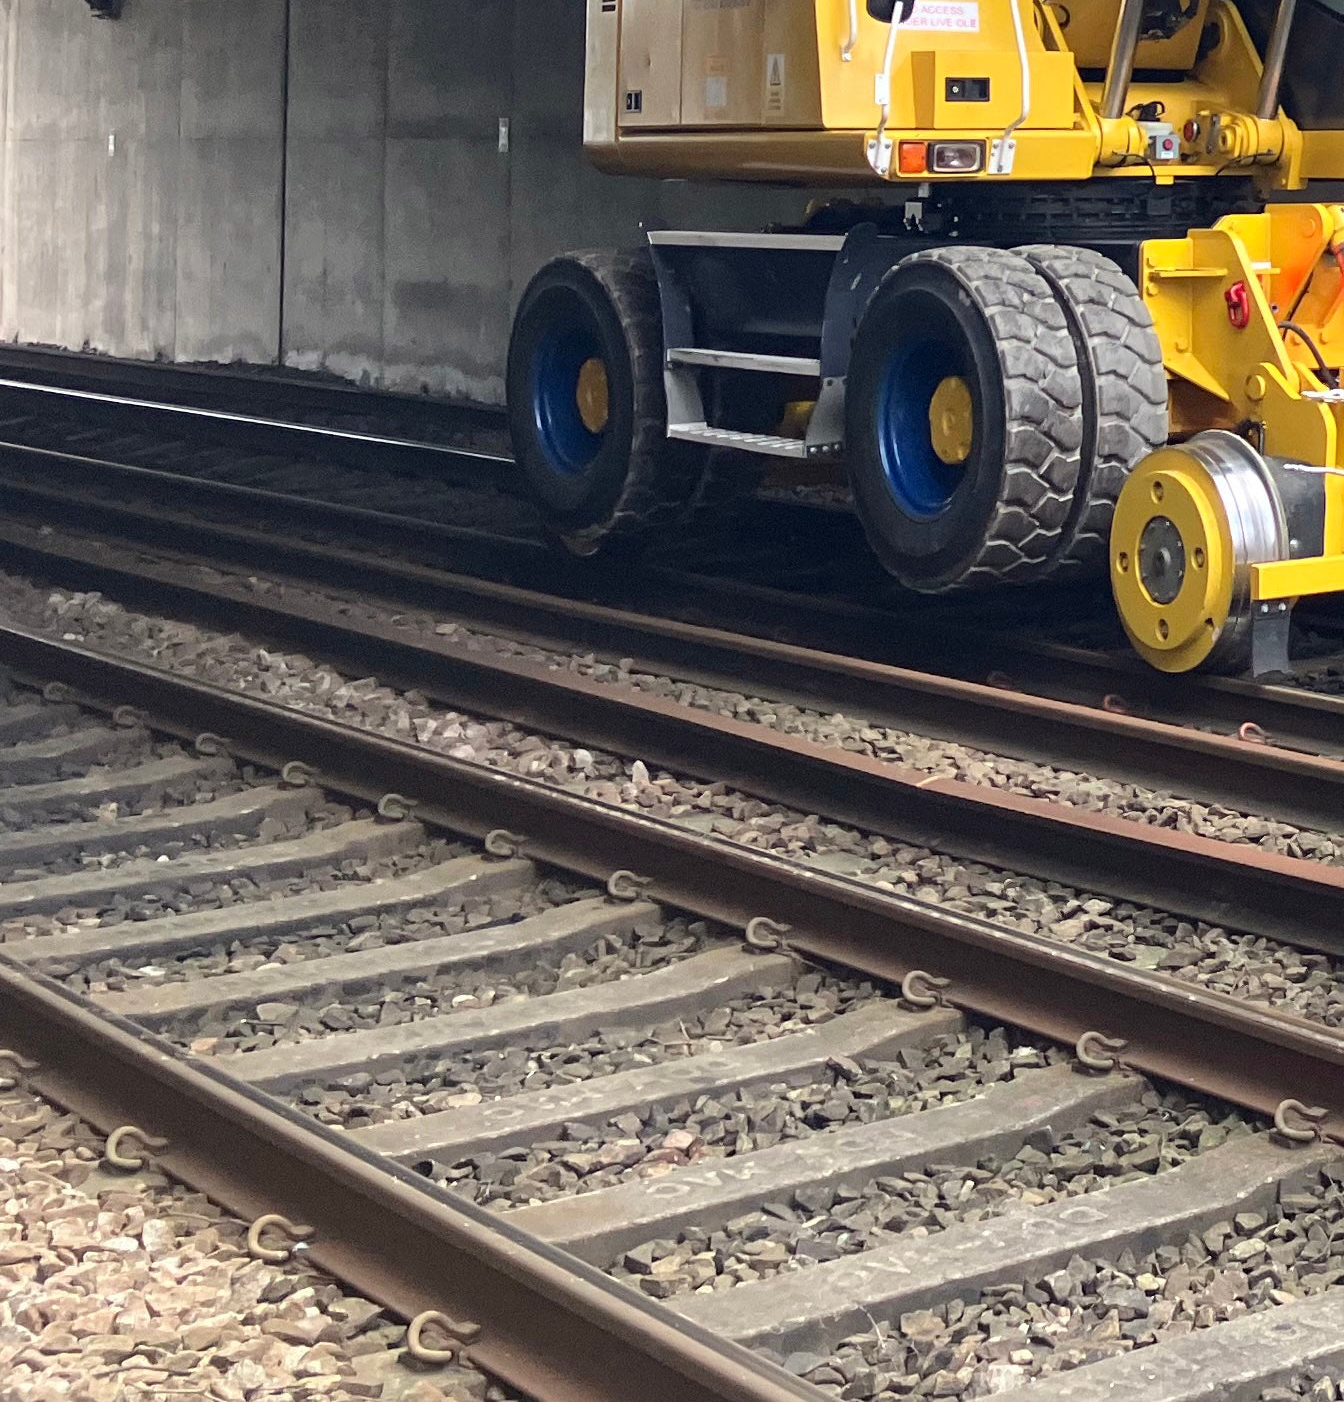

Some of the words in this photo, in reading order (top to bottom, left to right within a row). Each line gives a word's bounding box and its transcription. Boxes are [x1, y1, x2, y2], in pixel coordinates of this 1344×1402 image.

[921, 5, 964, 15] ACCESS
[930, 18, 953, 28] LIVE
[955, 19, 977, 29] OLE
